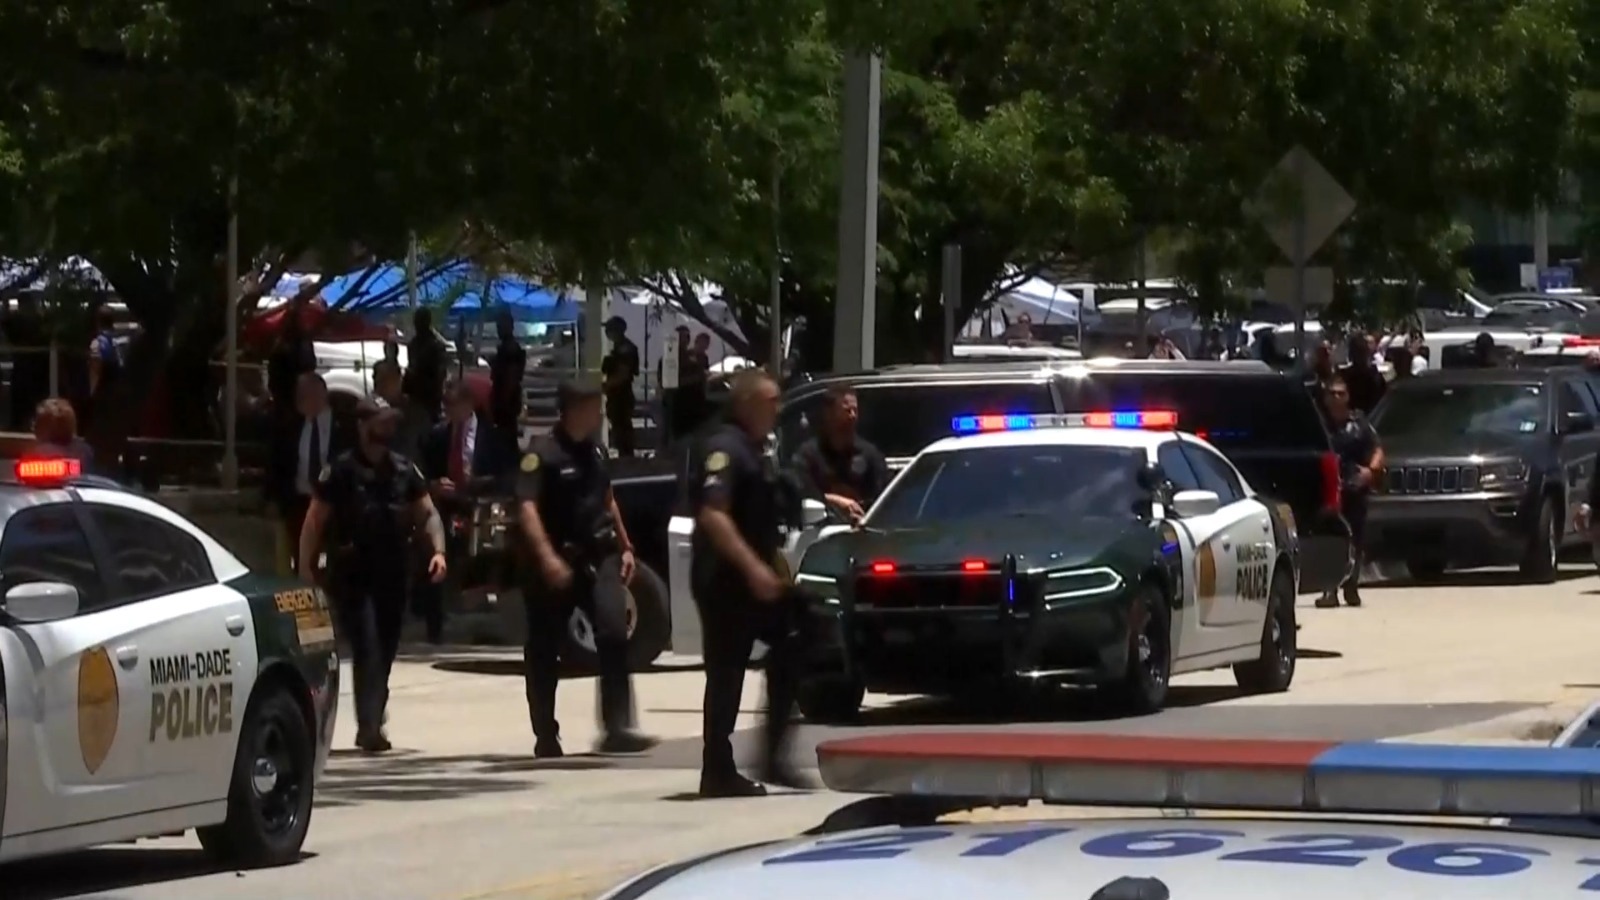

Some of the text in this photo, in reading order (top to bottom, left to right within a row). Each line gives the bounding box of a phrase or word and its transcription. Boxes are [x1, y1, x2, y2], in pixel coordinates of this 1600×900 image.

[1235, 564, 1268, 602] POLICE
[150, 648, 232, 686] MIAMI-DADE
[149, 682, 233, 743] POLICE
